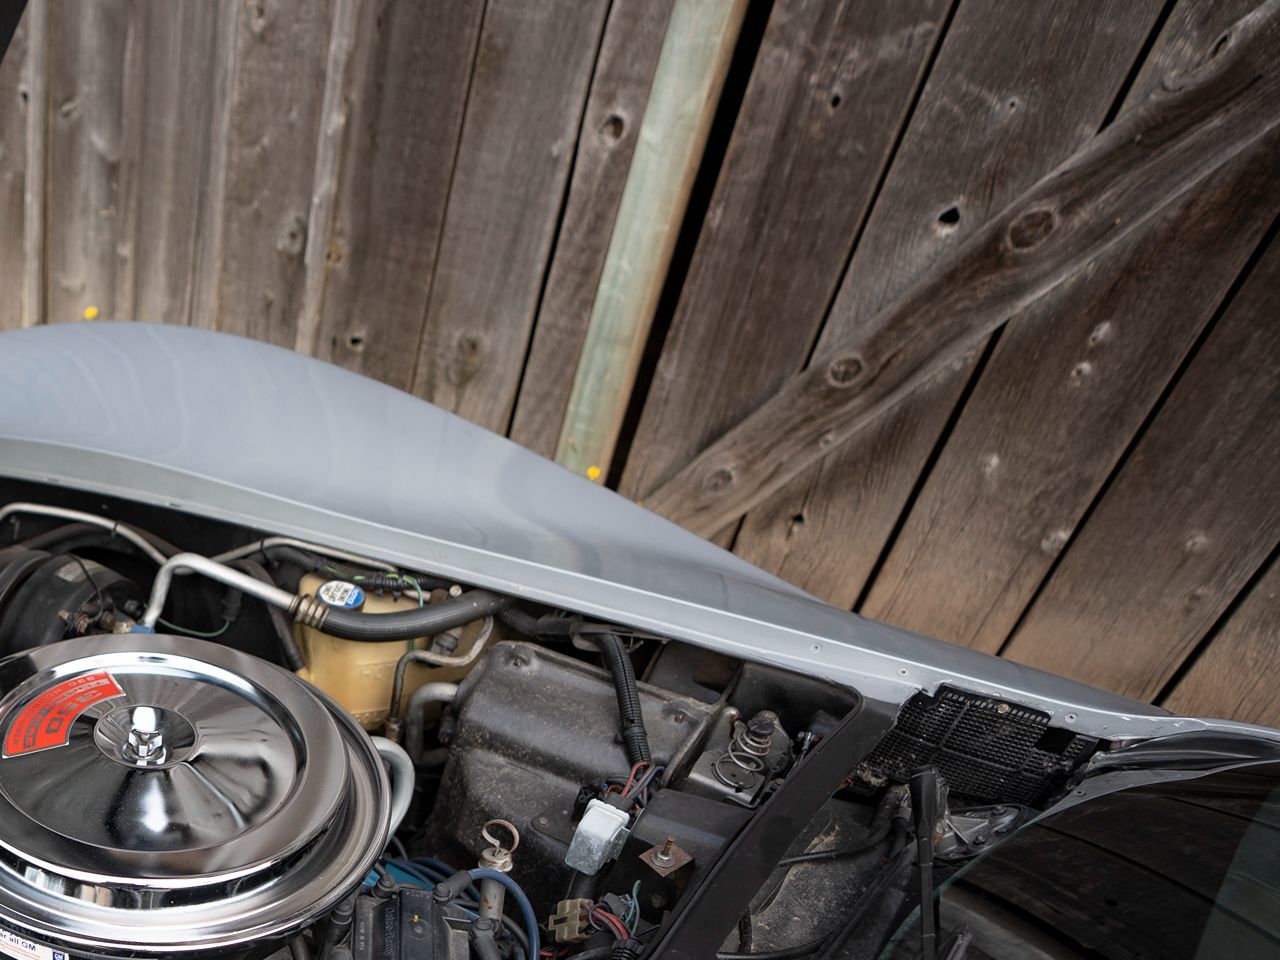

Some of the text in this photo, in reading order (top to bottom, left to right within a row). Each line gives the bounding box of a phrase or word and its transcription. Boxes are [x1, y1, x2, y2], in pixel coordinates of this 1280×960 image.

[46, 690, 103, 733] 350
[9, 936, 19, 945] all
[21, 941, 36, 951] GM
